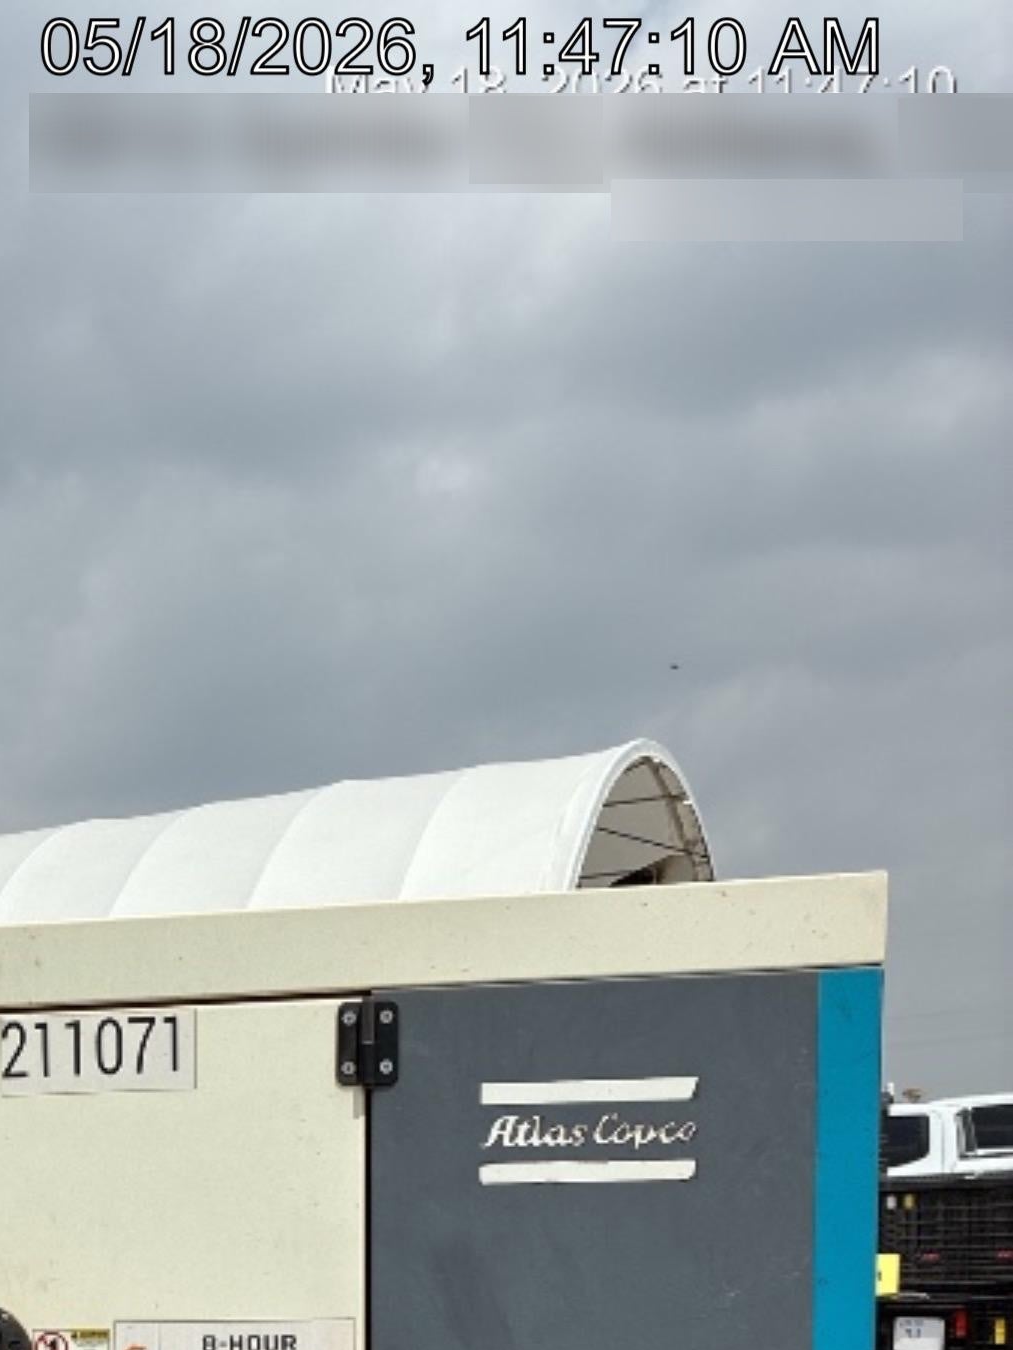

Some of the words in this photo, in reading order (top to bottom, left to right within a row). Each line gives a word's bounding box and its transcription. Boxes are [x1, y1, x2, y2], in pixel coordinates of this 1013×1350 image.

[0, 1013, 178, 1079] 211071
[479, 1114, 588, 1149] Atlas
[592, 1112, 697, 1149] Copco
